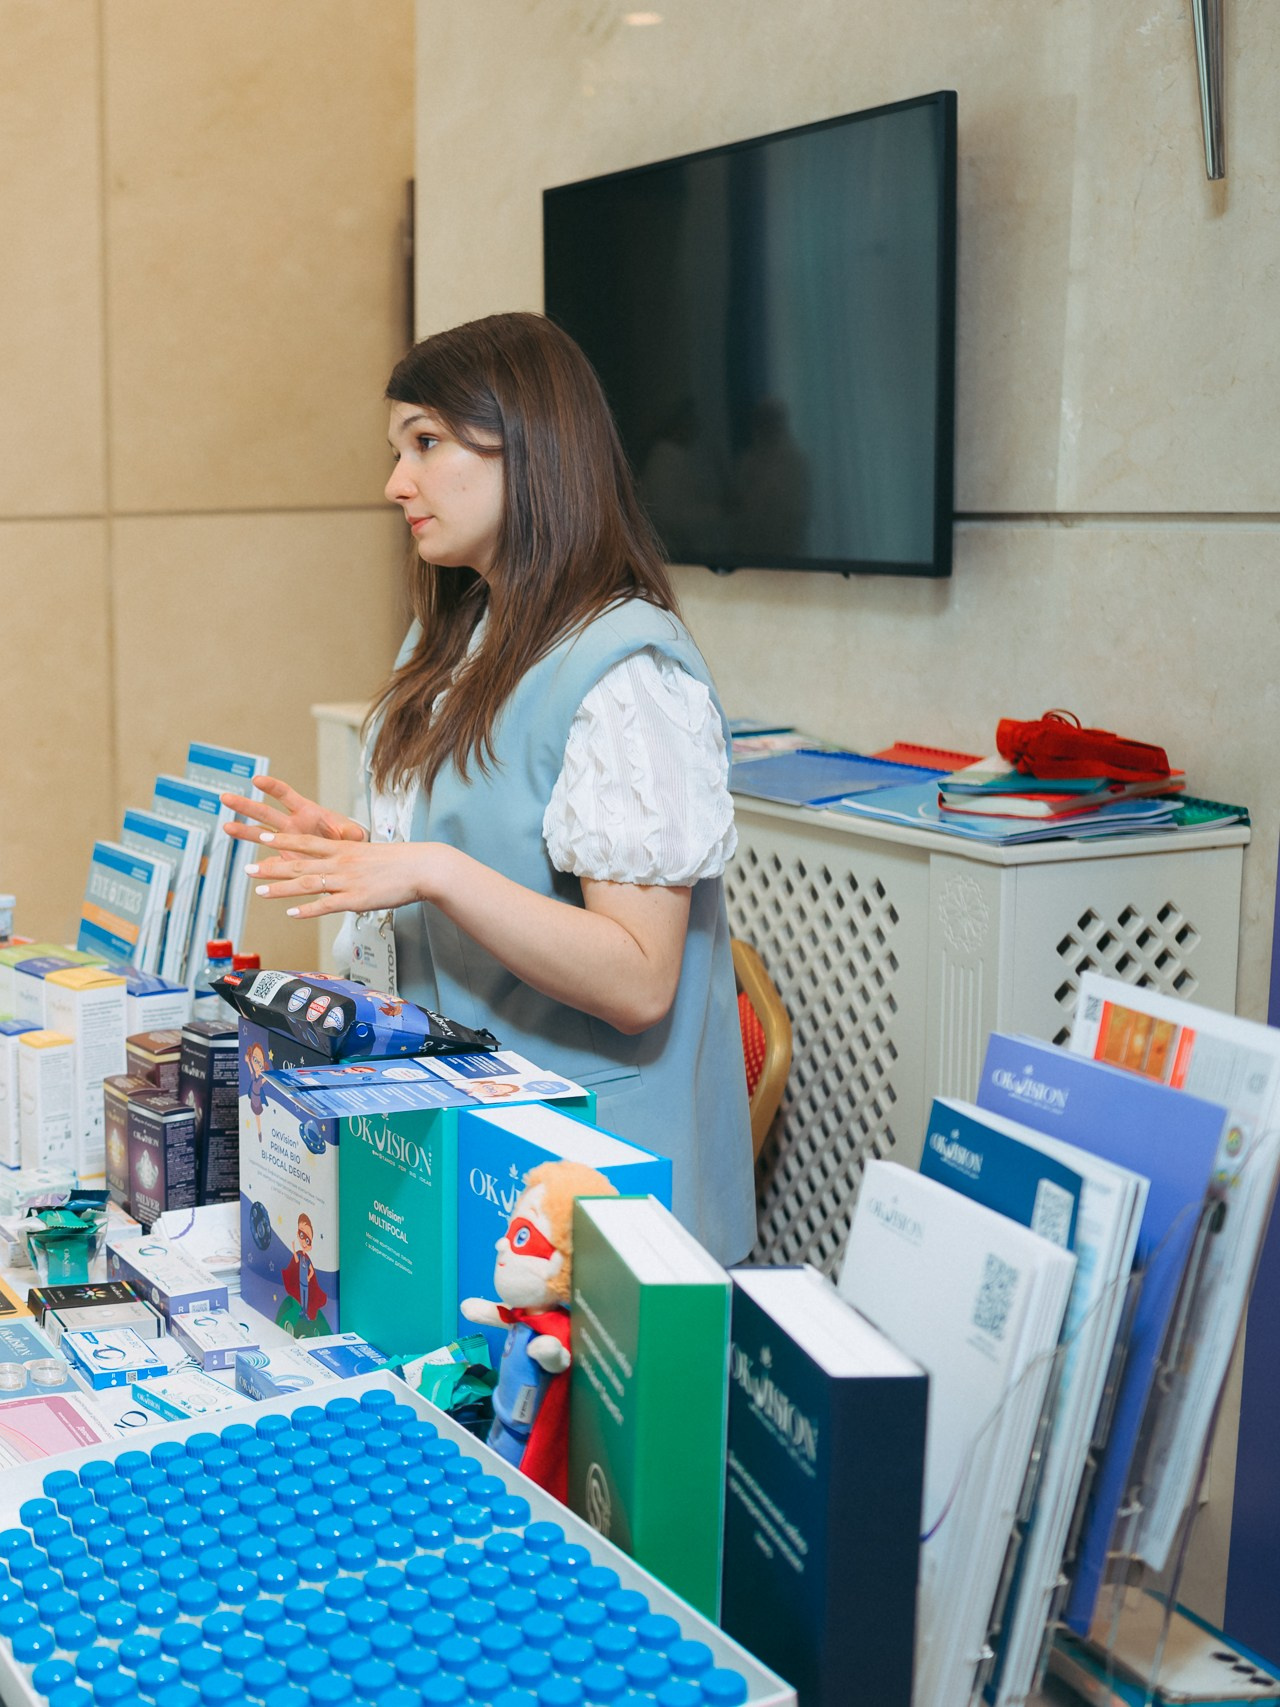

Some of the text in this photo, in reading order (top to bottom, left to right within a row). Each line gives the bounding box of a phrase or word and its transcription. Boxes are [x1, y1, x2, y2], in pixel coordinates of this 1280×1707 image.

[991, 1068, 1069, 1109] OKVISION
[270, 1141, 301, 1165] PRIMA BIO
[348, 1115, 432, 1176] OKVISION
[929, 1132, 984, 1173] OKVISION
[261, 1149, 288, 1172] BI-FOCAL
[288, 1164, 311, 1184] DESIGN
[135, 1191, 160, 1212] SILVER
[368, 1211, 409, 1244] MULTIFOCAL
